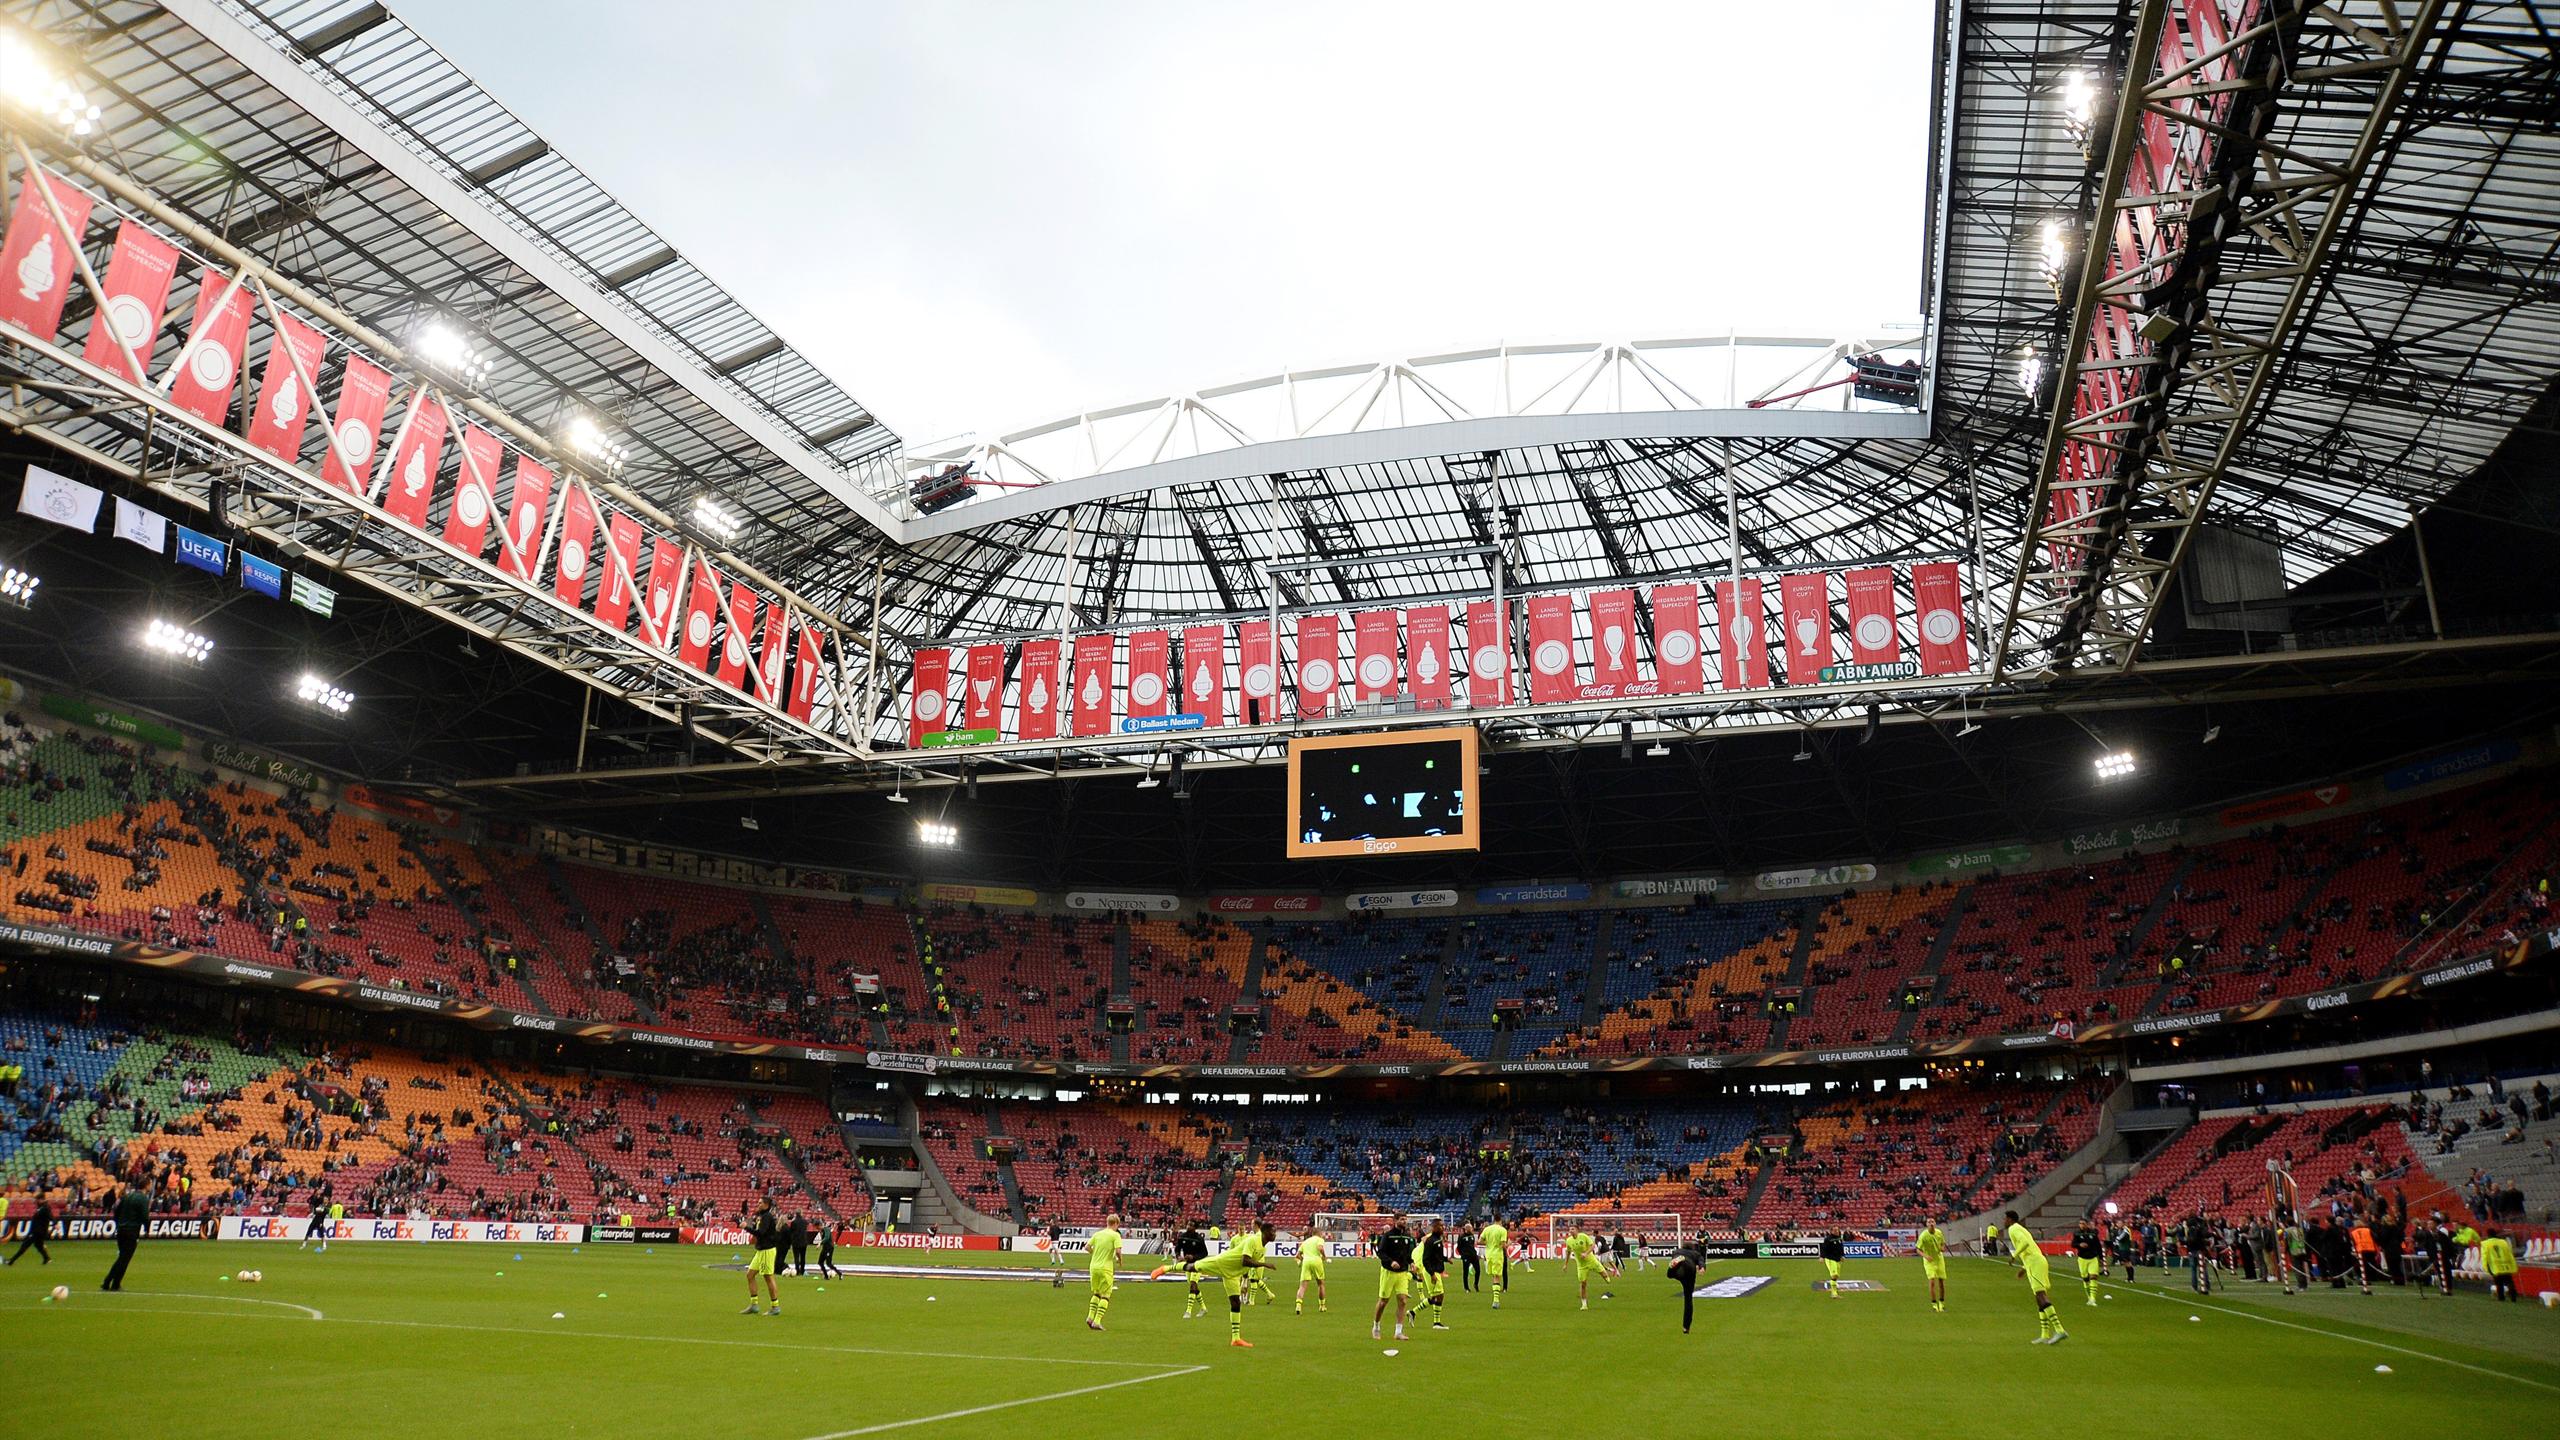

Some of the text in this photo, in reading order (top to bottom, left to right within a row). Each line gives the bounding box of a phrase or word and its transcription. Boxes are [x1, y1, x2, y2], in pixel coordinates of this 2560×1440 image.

[181, 539, 222, 564] UEFA
[1849, 579, 1890, 587] NEDERLANDSE
[1655, 595, 1694, 604] NEDERLANDSE
[110, 714, 137, 734] bam
[1140, 718, 1198, 728] Ballast Nedam
[956, 732, 974, 741] bam
[212, 743, 313, 790] Grolsch Grolsch
[2431, 749, 2491, 778] randstad
[2070, 818, 2181, 854] Grolsch Grolsch
[1963, 852, 1991, 866] bam
[1778, 874, 1800, 886] kpn
[1517, 886, 1568, 900] randstad
[20, 930, 112, 954] EUROPA LEAGUE
[2422, 958, 2494, 986] UEFA EUROPA LEAGUE
[360, 987, 440, 1010] UEFA EUROPA LEAGUE
[2315, 992, 2349, 1010] UniCredit
[522, 1017, 555, 1030] UniCredit
[2133, 1012, 2221, 1033] UEFA EUROPA LEAGUE
[632, 1032, 714, 1049] UEFA EUROPA LEAGUE
[1818, 1048, 1908, 1062] UEFA EUROPA LEAGUE
[982, 1062, 1013, 1070] LEAGUE
[1379, 1066, 1410, 1074] AMSTEL
[1501, 1062, 1589, 1072] UEFA EUROPA LEAGUE
[1688, 1058, 1722, 1069] FedEx
[1202, 1068, 1286, 1076] UEFA EUROPA LEAGUE
[239, 1218, 568, 1242] FedEx FedEx FedEx FedEx FedEx
[592, 1228, 670, 1240] enterprise rent-a-car
[705, 1228, 750, 1245] UniCredit
[932, 1236, 964, 1248] BIER
[1760, 1244, 1818, 1256] enterprise
[1843, 1246, 1881, 1254] RESPECT
